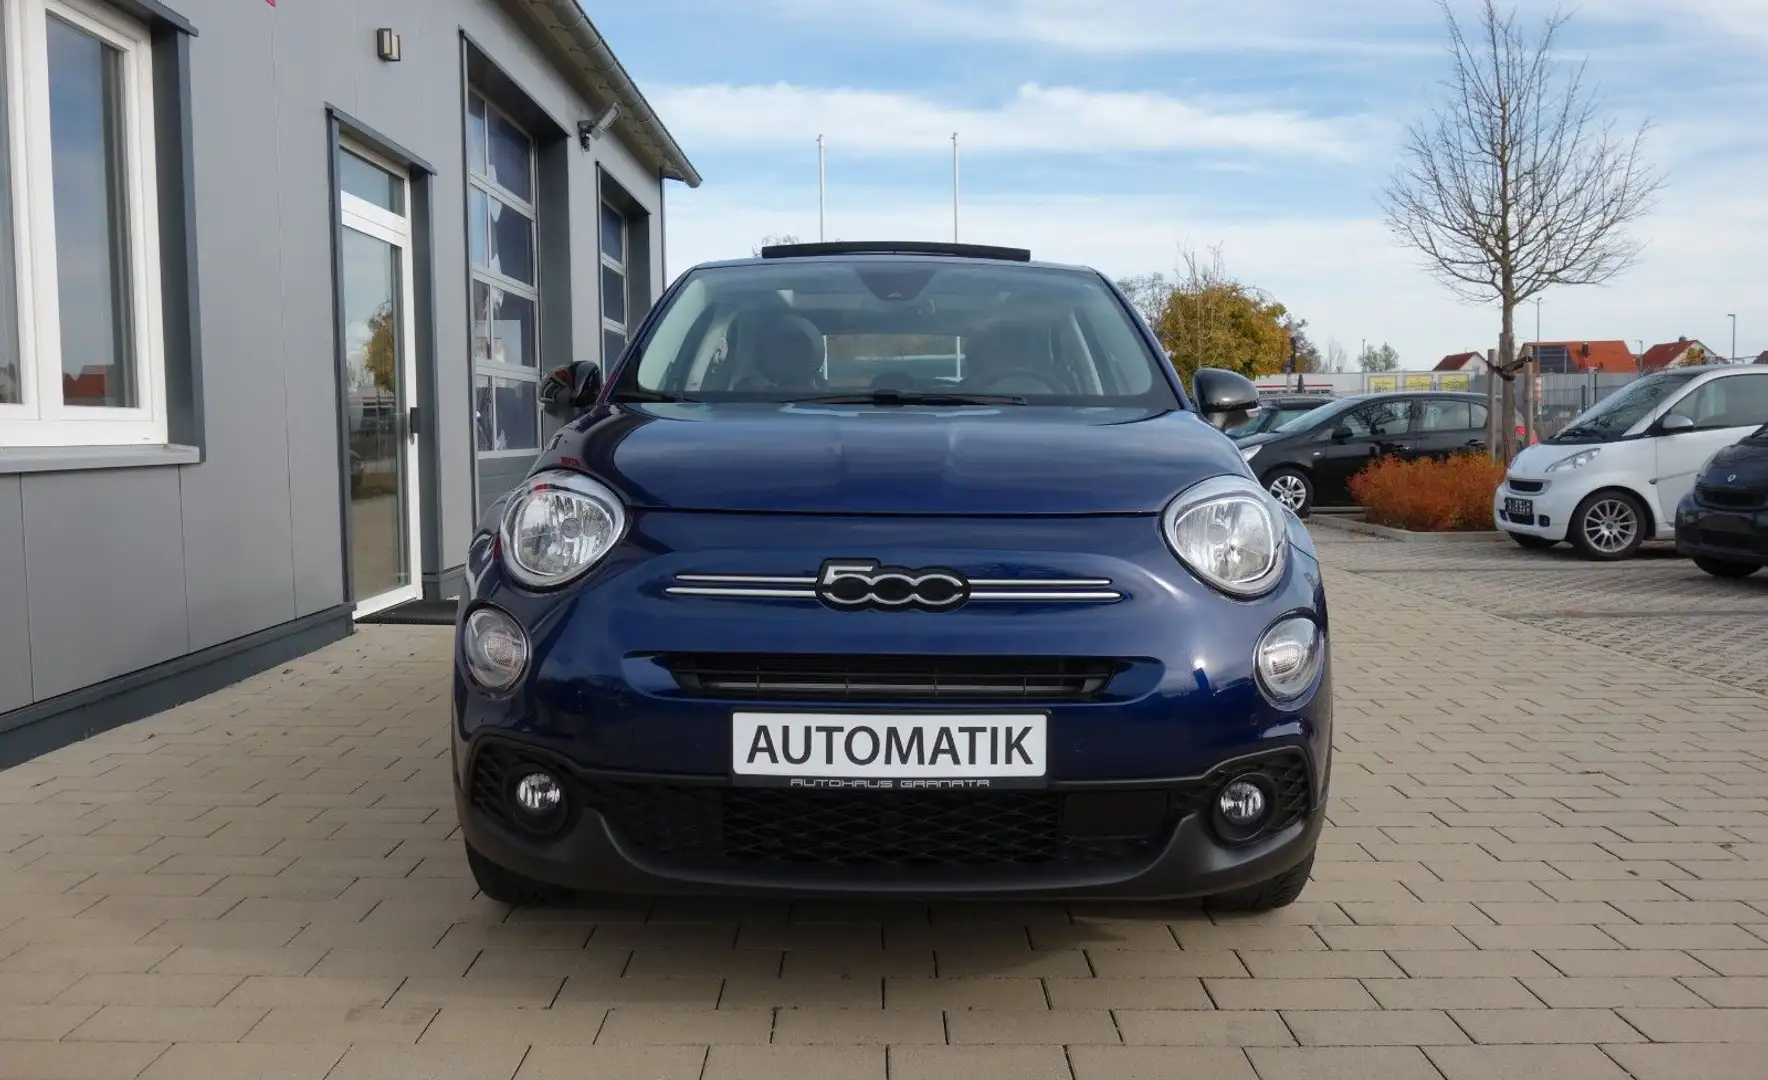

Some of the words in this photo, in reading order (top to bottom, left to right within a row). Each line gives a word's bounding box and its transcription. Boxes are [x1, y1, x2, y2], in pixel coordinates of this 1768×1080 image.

[820, 563, 966, 606] 500
[746, 725, 1034, 766] AUTOMATIK
[790, 778, 893, 789] AUTOHAUS
[900, 779, 990, 789] GRANATA
